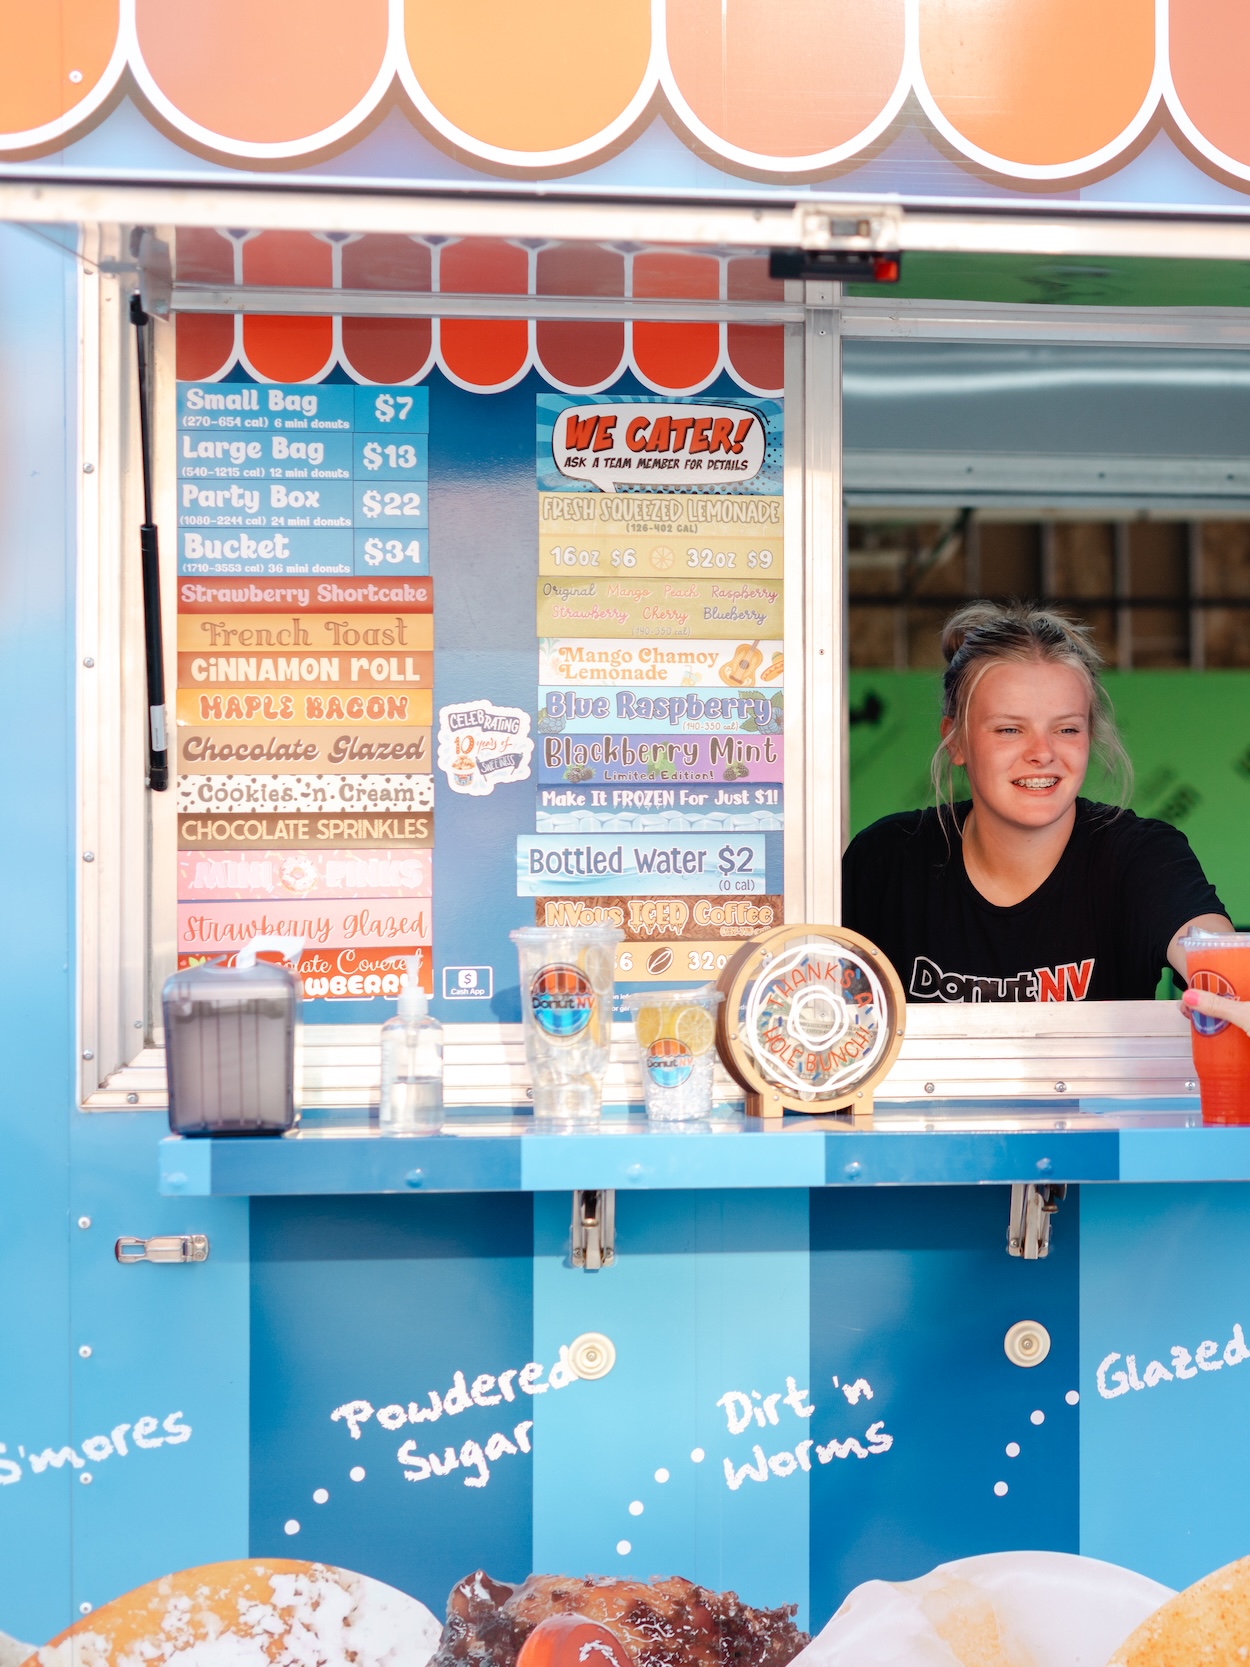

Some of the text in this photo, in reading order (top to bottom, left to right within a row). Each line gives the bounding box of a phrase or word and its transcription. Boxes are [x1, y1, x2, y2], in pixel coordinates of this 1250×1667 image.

[186, 388, 414, 422] Small Bag $7
[182, 416, 350, 429] (270-654 cal) 6 mini donuts
[566, 414, 754, 454] WE CATER!
[182, 436, 417, 470] Large Bag $13
[564, 456, 748, 470] ASK A TEAM MEMBER FOR DETAILS
[182, 467, 350, 479] (540-1215 cal) 12 mini donuts
[182, 484, 420, 518] Party Box $22
[544, 496, 780, 524] FRESH SQUEEZED LEMONADE
[246, 516, 266, 526] cal)
[271, 516, 284, 526] 24
[288, 517, 310, 527] mini
[313, 517, 352, 527] donuts
[626, 523, 698, 534] (126-402 CAL)
[184, 533, 420, 566] Bucket $34
[610, 548, 637, 568] $6
[747, 550, 774, 570] $9
[182, 564, 350, 574] (1710-3553 cal) 36 mini donuts
[181, 584, 428, 607] Strawberry Shortcake
[543, 582, 778, 604] Original Mango Peach Raspberry
[552, 606, 768, 626] Strawberry Cherry Blueberry
[200, 617, 408, 646] French Toast
[674, 626, 690, 637] cal)
[558, 646, 720, 668] Mango Chamoy
[558, 664, 668, 680] Lemonade
[199, 694, 409, 721] MAPLE BACON
[546, 691, 772, 726] Blue Raspberry
[682, 720, 740, 732] (140-350 cal)
[182, 734, 426, 764] Chocolate Glazed
[454, 735, 475, 754] 10
[500, 737, 512, 753] of
[544, 736, 778, 767] Blackberry Mint
[604, 770, 714, 780] Limited Edition!
[197, 783, 294, 803] Cookies
[338, 783, 415, 803] Cream
[542, 789, 778, 810] Make It FROZEN For Just $1!
[182, 818, 428, 841] CHOCOLATE SPRINKLES
[529, 845, 623, 875] Bottled
[718, 844, 754, 877] $2
[193, 858, 424, 890] MINI PINKS
[718, 880, 755, 892] (0 cal)
[184, 915, 334, 943] Strawberry
[545, 900, 774, 935] NVous ICED Coffee
[688, 951, 733, 970] 32o
[451, 988, 485, 997] Cash App
[767, 962, 873, 1008] THANKS A
[762, 1026, 872, 1072] HOLE BUNCH!
[1097, 1322, 1250, 1399] Glazed
[330, 1344, 580, 1439] Powdered
[716, 1374, 875, 1435] Dirt 'n
[0, 1411, 193, 1485] S'mores
[398, 1418, 535, 1488] Sugar
[723, 1420, 895, 1492] Worms
